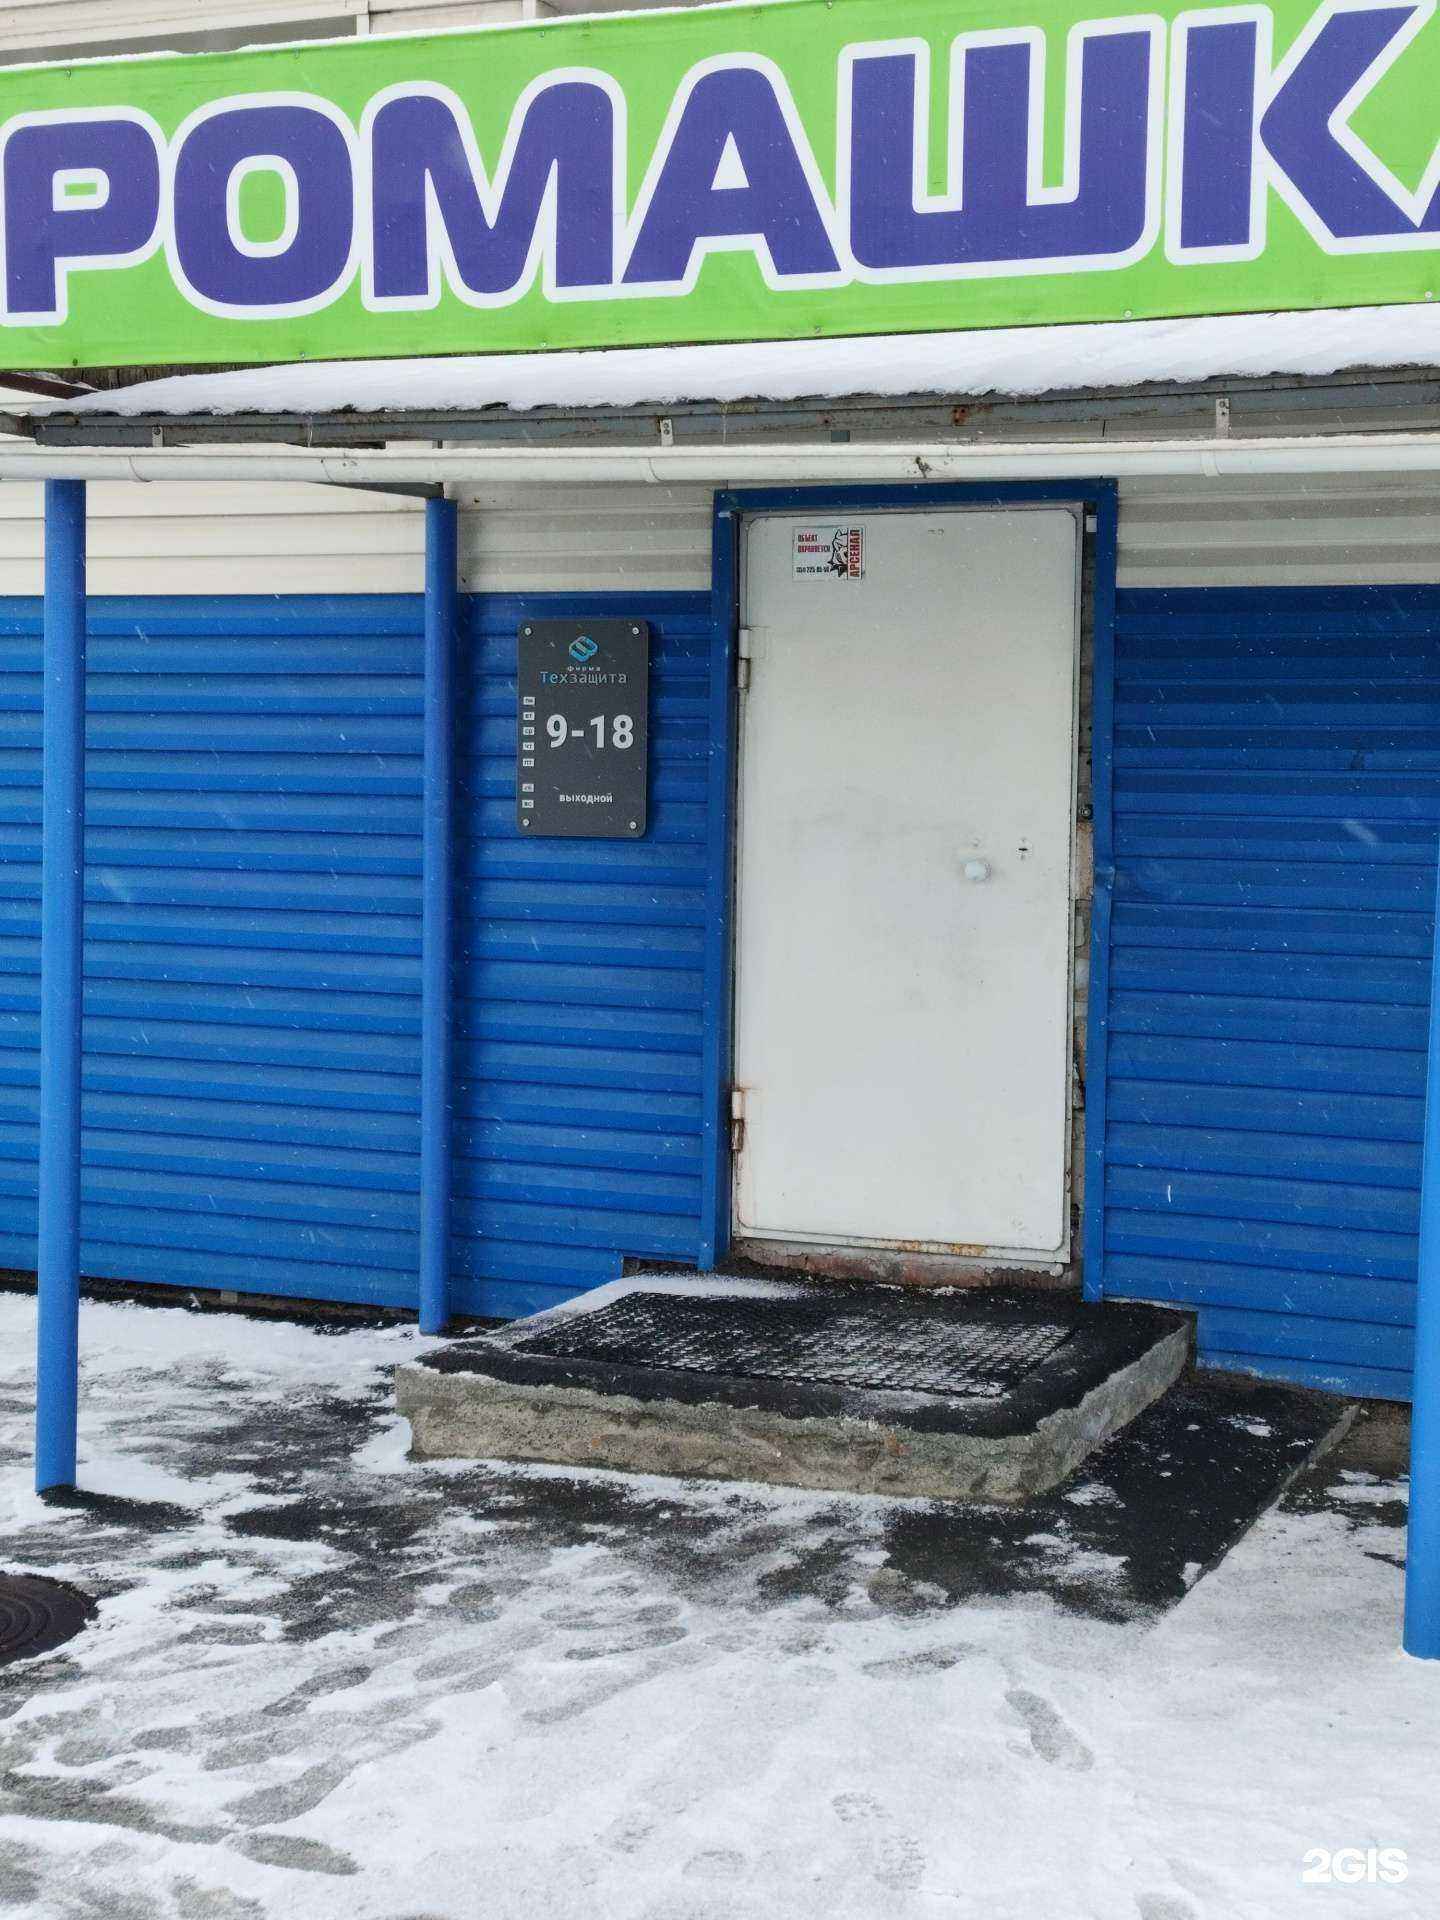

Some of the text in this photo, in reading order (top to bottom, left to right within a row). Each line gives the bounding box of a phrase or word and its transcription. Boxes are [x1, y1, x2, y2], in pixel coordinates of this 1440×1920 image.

[0, 4, 1440, 318] РОМАШК
[849, 529, 860, 578] АРСЕНАЛ
[540, 671, 627, 685] Техзащита
[546, 714, 634, 749] 9-18
[559, 792, 613, 804] выходной
